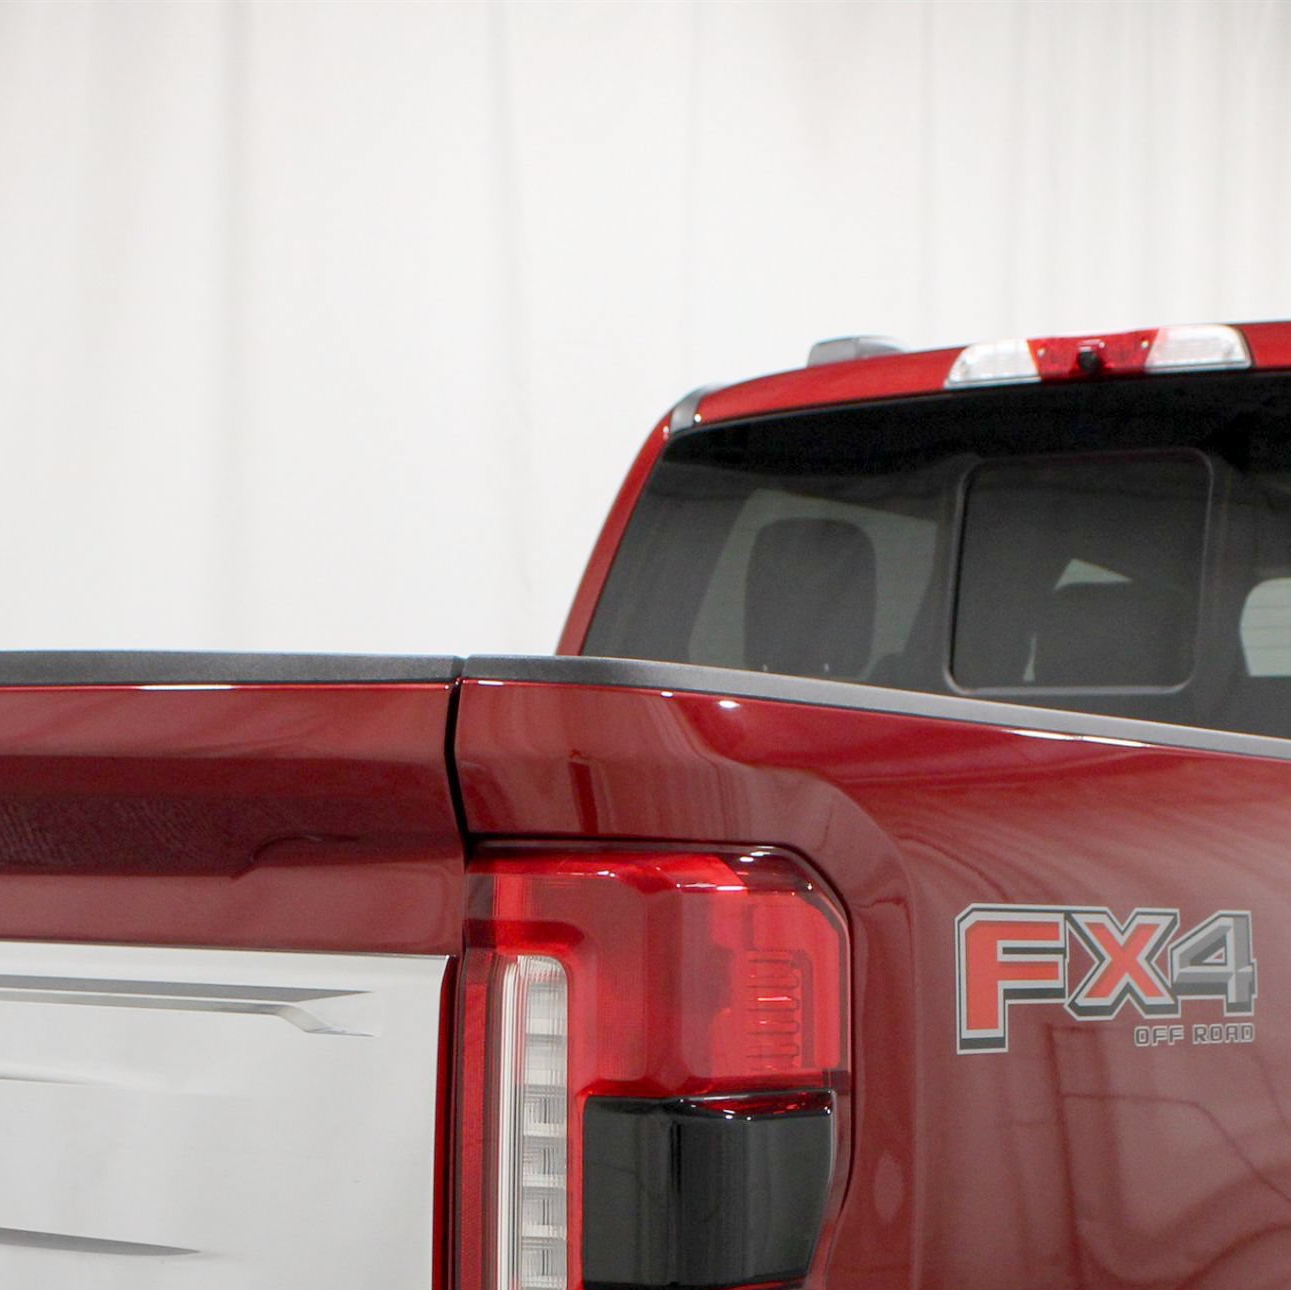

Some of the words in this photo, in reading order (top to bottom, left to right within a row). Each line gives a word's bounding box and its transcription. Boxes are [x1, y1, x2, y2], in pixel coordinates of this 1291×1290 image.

[955, 902, 1258, 1055] FX4
[1134, 1024, 1185, 1047] OFF
[1192, 1022, 1255, 1045] ROAD
